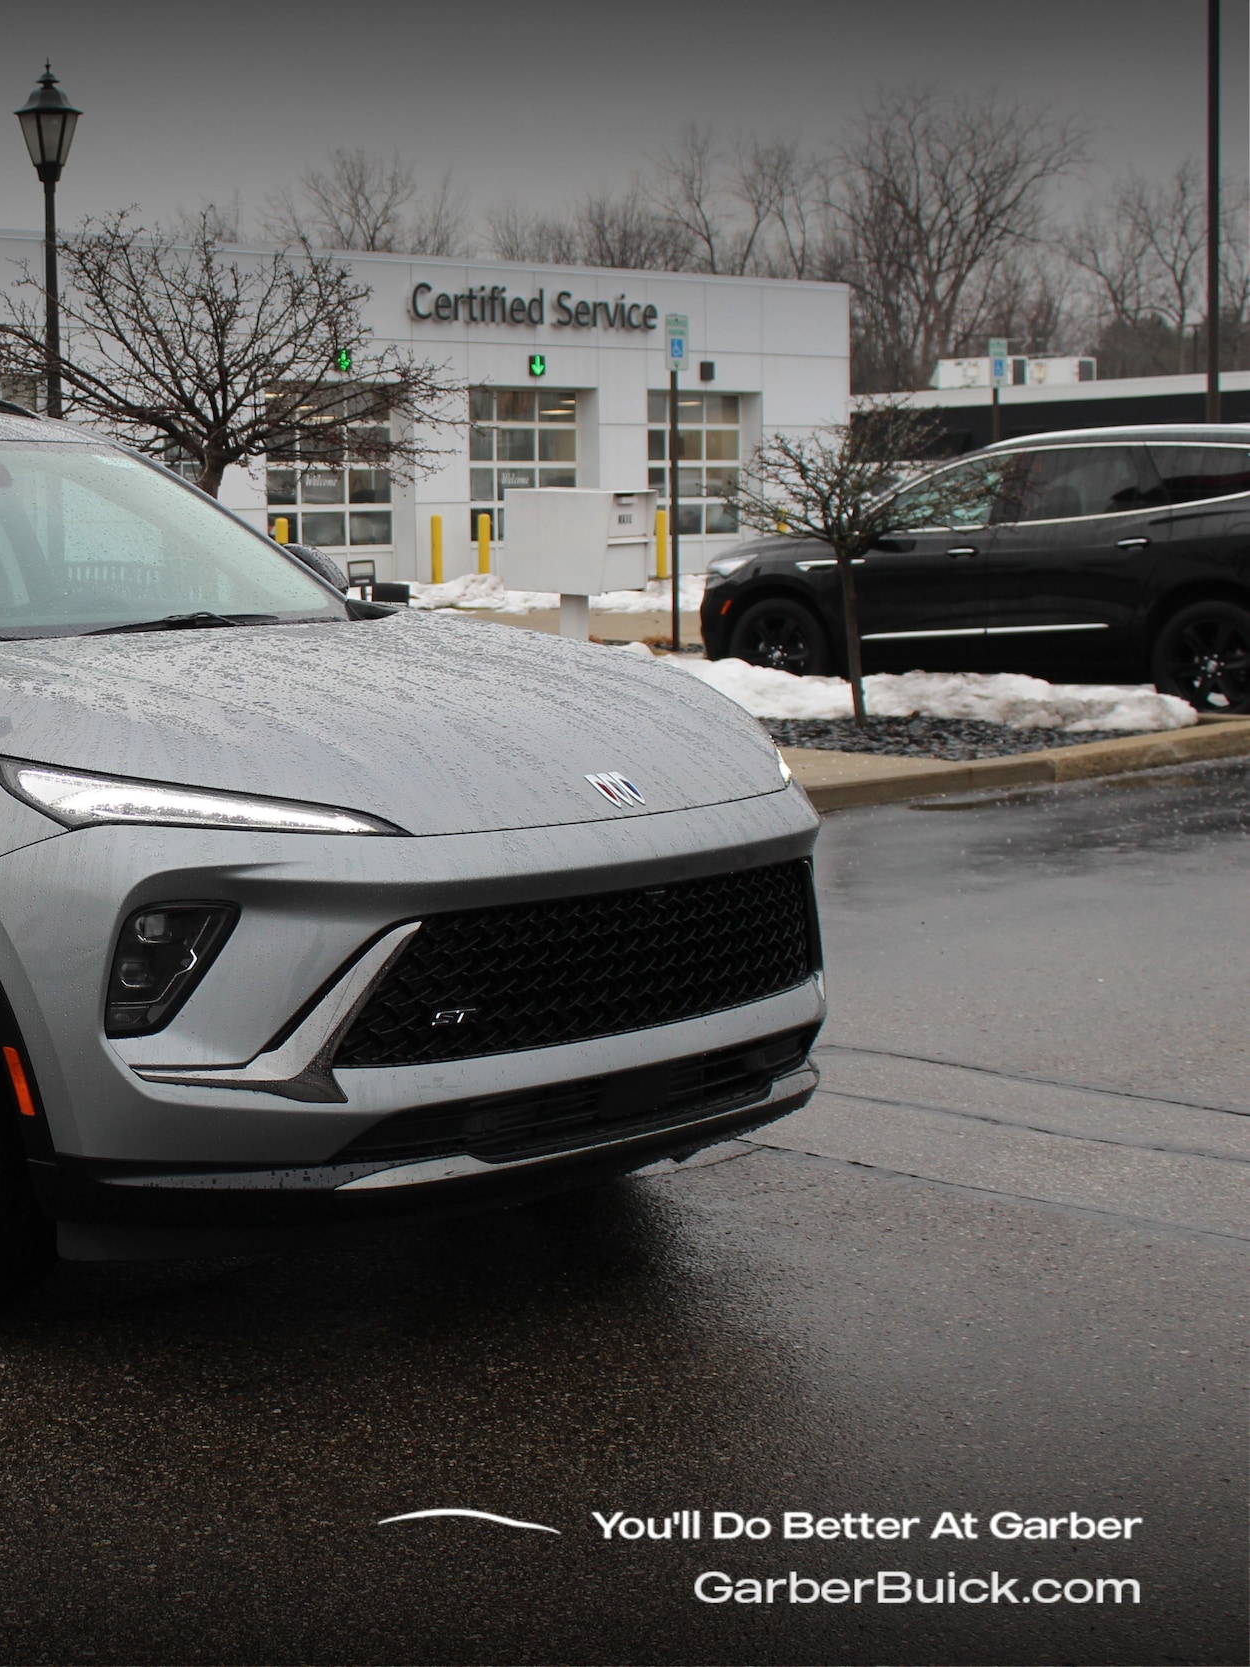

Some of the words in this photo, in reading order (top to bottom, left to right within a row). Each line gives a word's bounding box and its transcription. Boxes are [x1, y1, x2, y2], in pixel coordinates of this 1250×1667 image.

[411, 281, 545, 326] Certified
[556, 290, 658, 330] Service
[431, 1007, 477, 1026] ST
